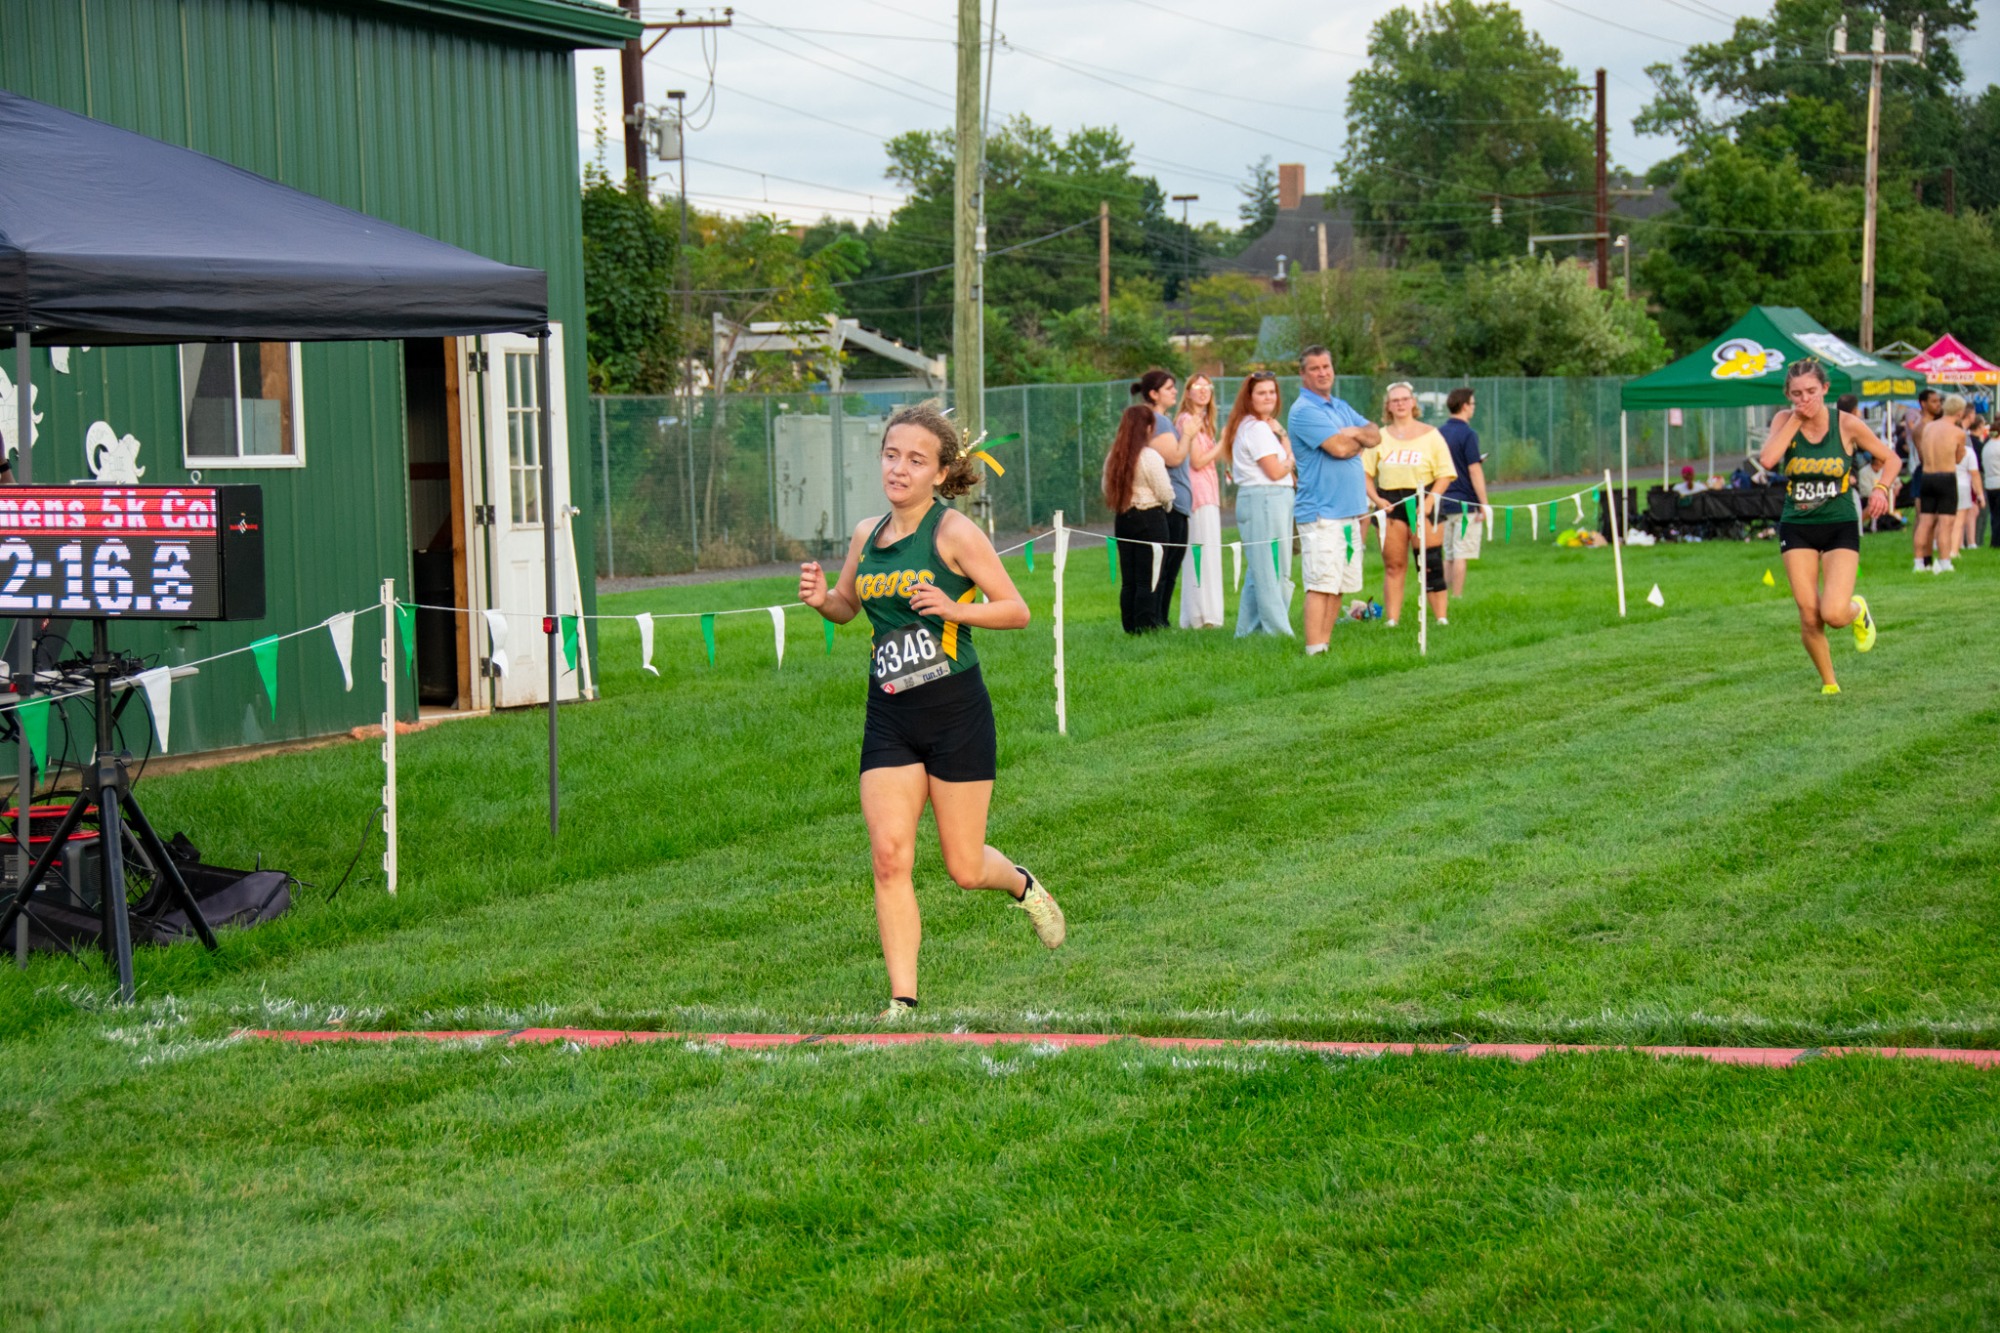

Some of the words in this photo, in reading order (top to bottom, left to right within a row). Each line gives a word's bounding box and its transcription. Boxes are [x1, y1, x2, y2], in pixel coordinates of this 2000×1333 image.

[101, 490, 148, 527] 5k
[1795, 481, 1837, 500] 5344
[877, 629, 936, 678] 5346
